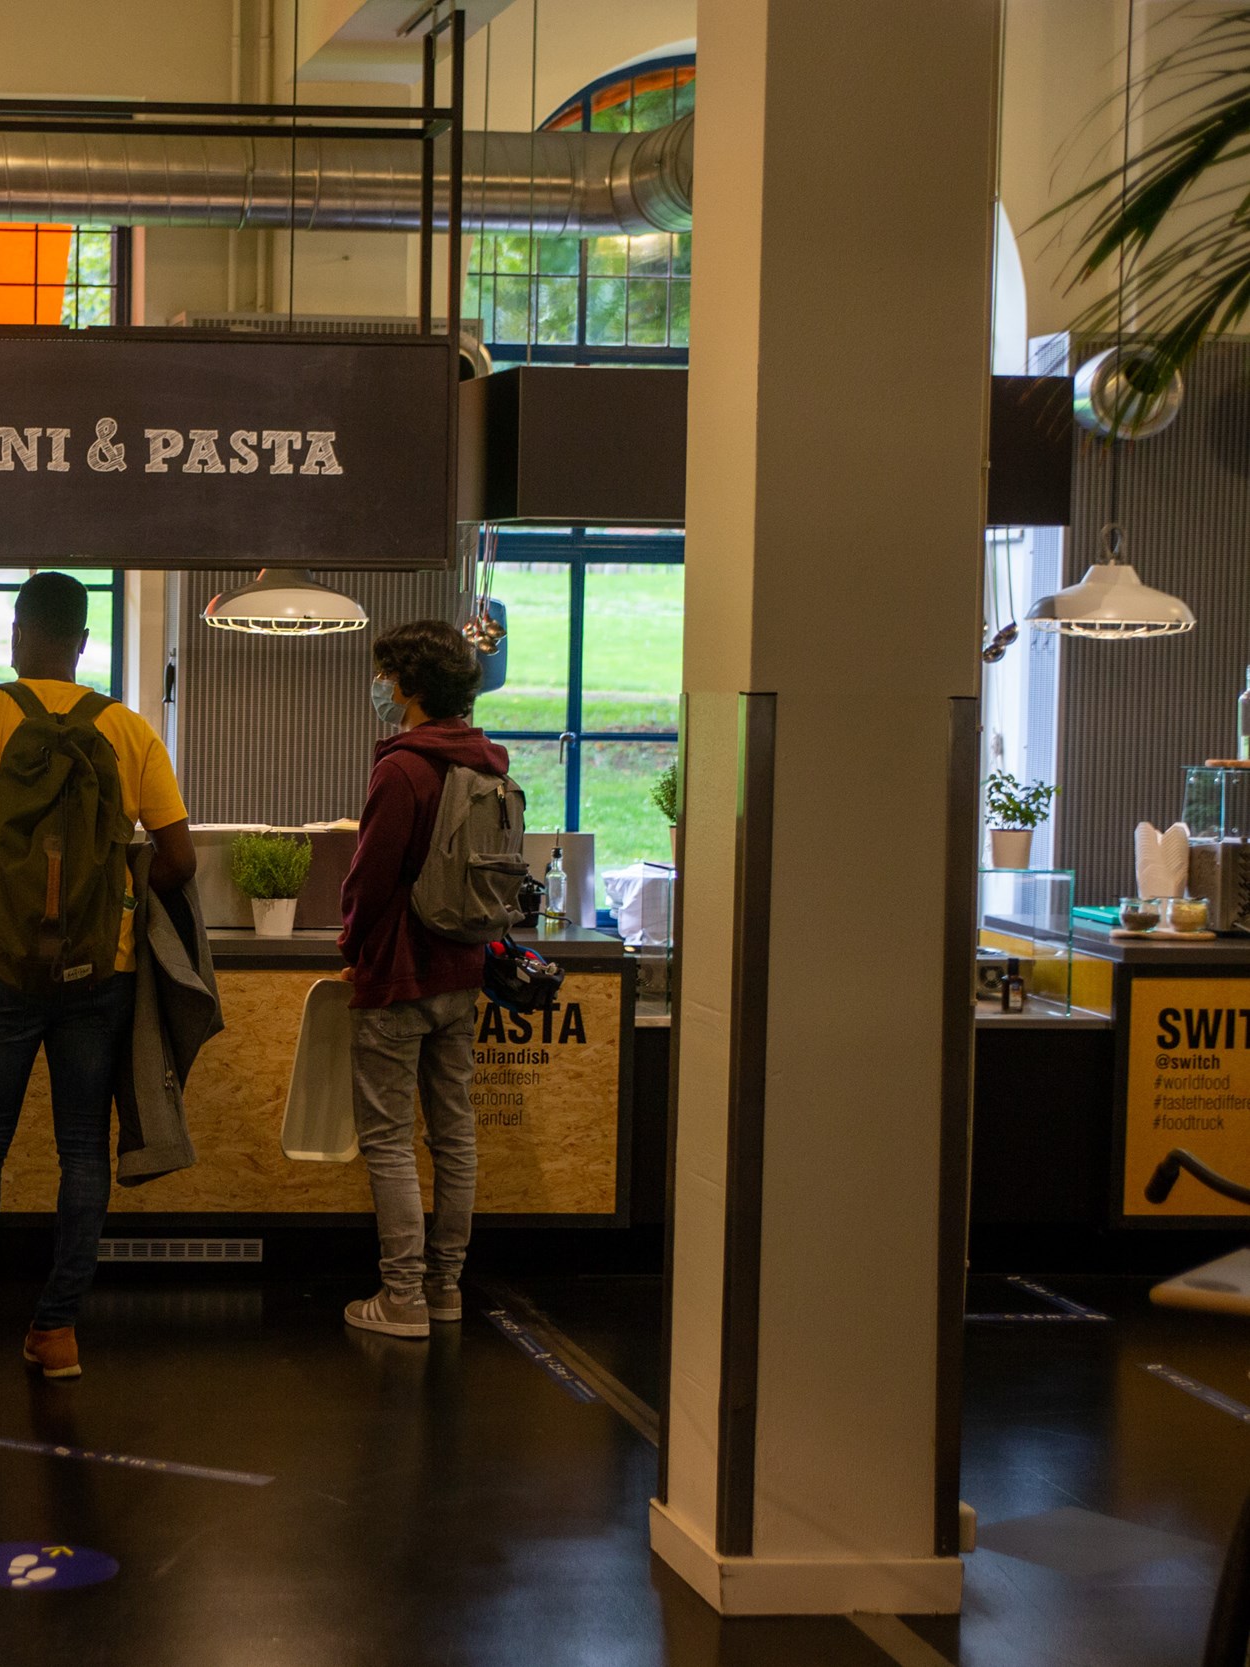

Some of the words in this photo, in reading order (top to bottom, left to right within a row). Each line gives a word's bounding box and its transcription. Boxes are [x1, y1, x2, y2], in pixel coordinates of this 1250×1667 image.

[87, 417, 128, 472] &
[145, 427, 344, 475] PASTA
[472, 1049, 549, 1065] taliandish
[1155, 1053, 1221, 1070] @switch
[471, 1069, 540, 1086] okedfresh
[1154, 1074, 1231, 1091] #worldfood
[469, 1091, 524, 1106] enonna
[474, 1109, 523, 1127] ianfuel
[1152, 1114, 1225, 1131] #foodtruck
